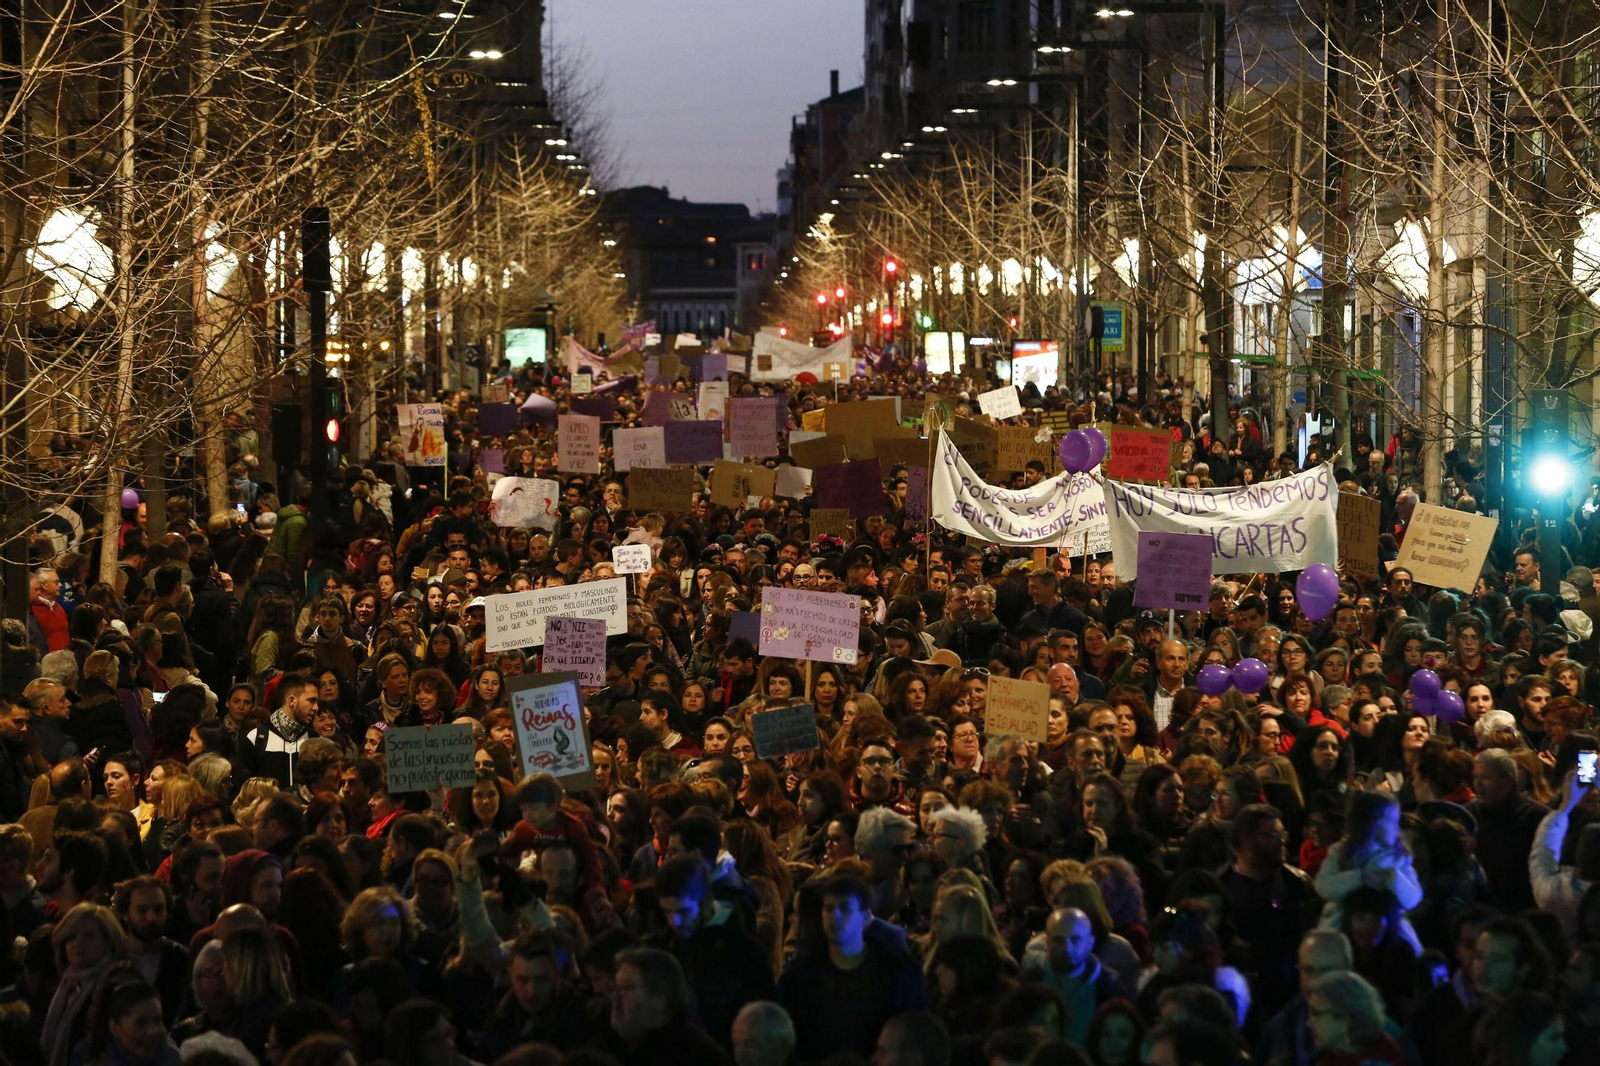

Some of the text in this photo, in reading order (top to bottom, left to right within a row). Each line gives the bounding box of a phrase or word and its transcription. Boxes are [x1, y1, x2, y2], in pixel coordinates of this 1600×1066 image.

[1001, 429, 1010, 438] LA
[1000, 442, 1051, 456] NO DA ASCO
[1009, 456, 1023, 469] DA
[1111, 483, 1154, 517] HOY
[1163, 490, 1217, 516] SOLO
[1026, 503, 1056, 520] SER
[495, 601, 509, 613] LOS
[516, 600, 533, 609] ROLES
[538, 592, 570, 604] FEMENINOS
[581, 586, 618, 598] MASCULINOS
[769, 592, 847, 607] NO MÁS AGRESIONES
[510, 610, 528, 620] ESTÁN
[533, 605, 558, 616] FIJADOS
[564, 596, 616, 609] BIOLÓGICAMENTE
[497, 625, 508, 633] SINO
[550, 620, 561, 632] NO
[801, 623, 853, 639] DESIGUALDAD
[502, 637, 534, 648] EDUQUEMOS
[807, 633, 841, 645] GÉNERO!
[522, 704, 575, 732] Reinas
[388, 734, 422, 751] Somos
[425, 733, 439, 748] las
[390, 754, 401, 768] de
[405, 751, 421, 767] las
[390, 773, 406, 786] no
[408, 766, 444, 789] pudiste
